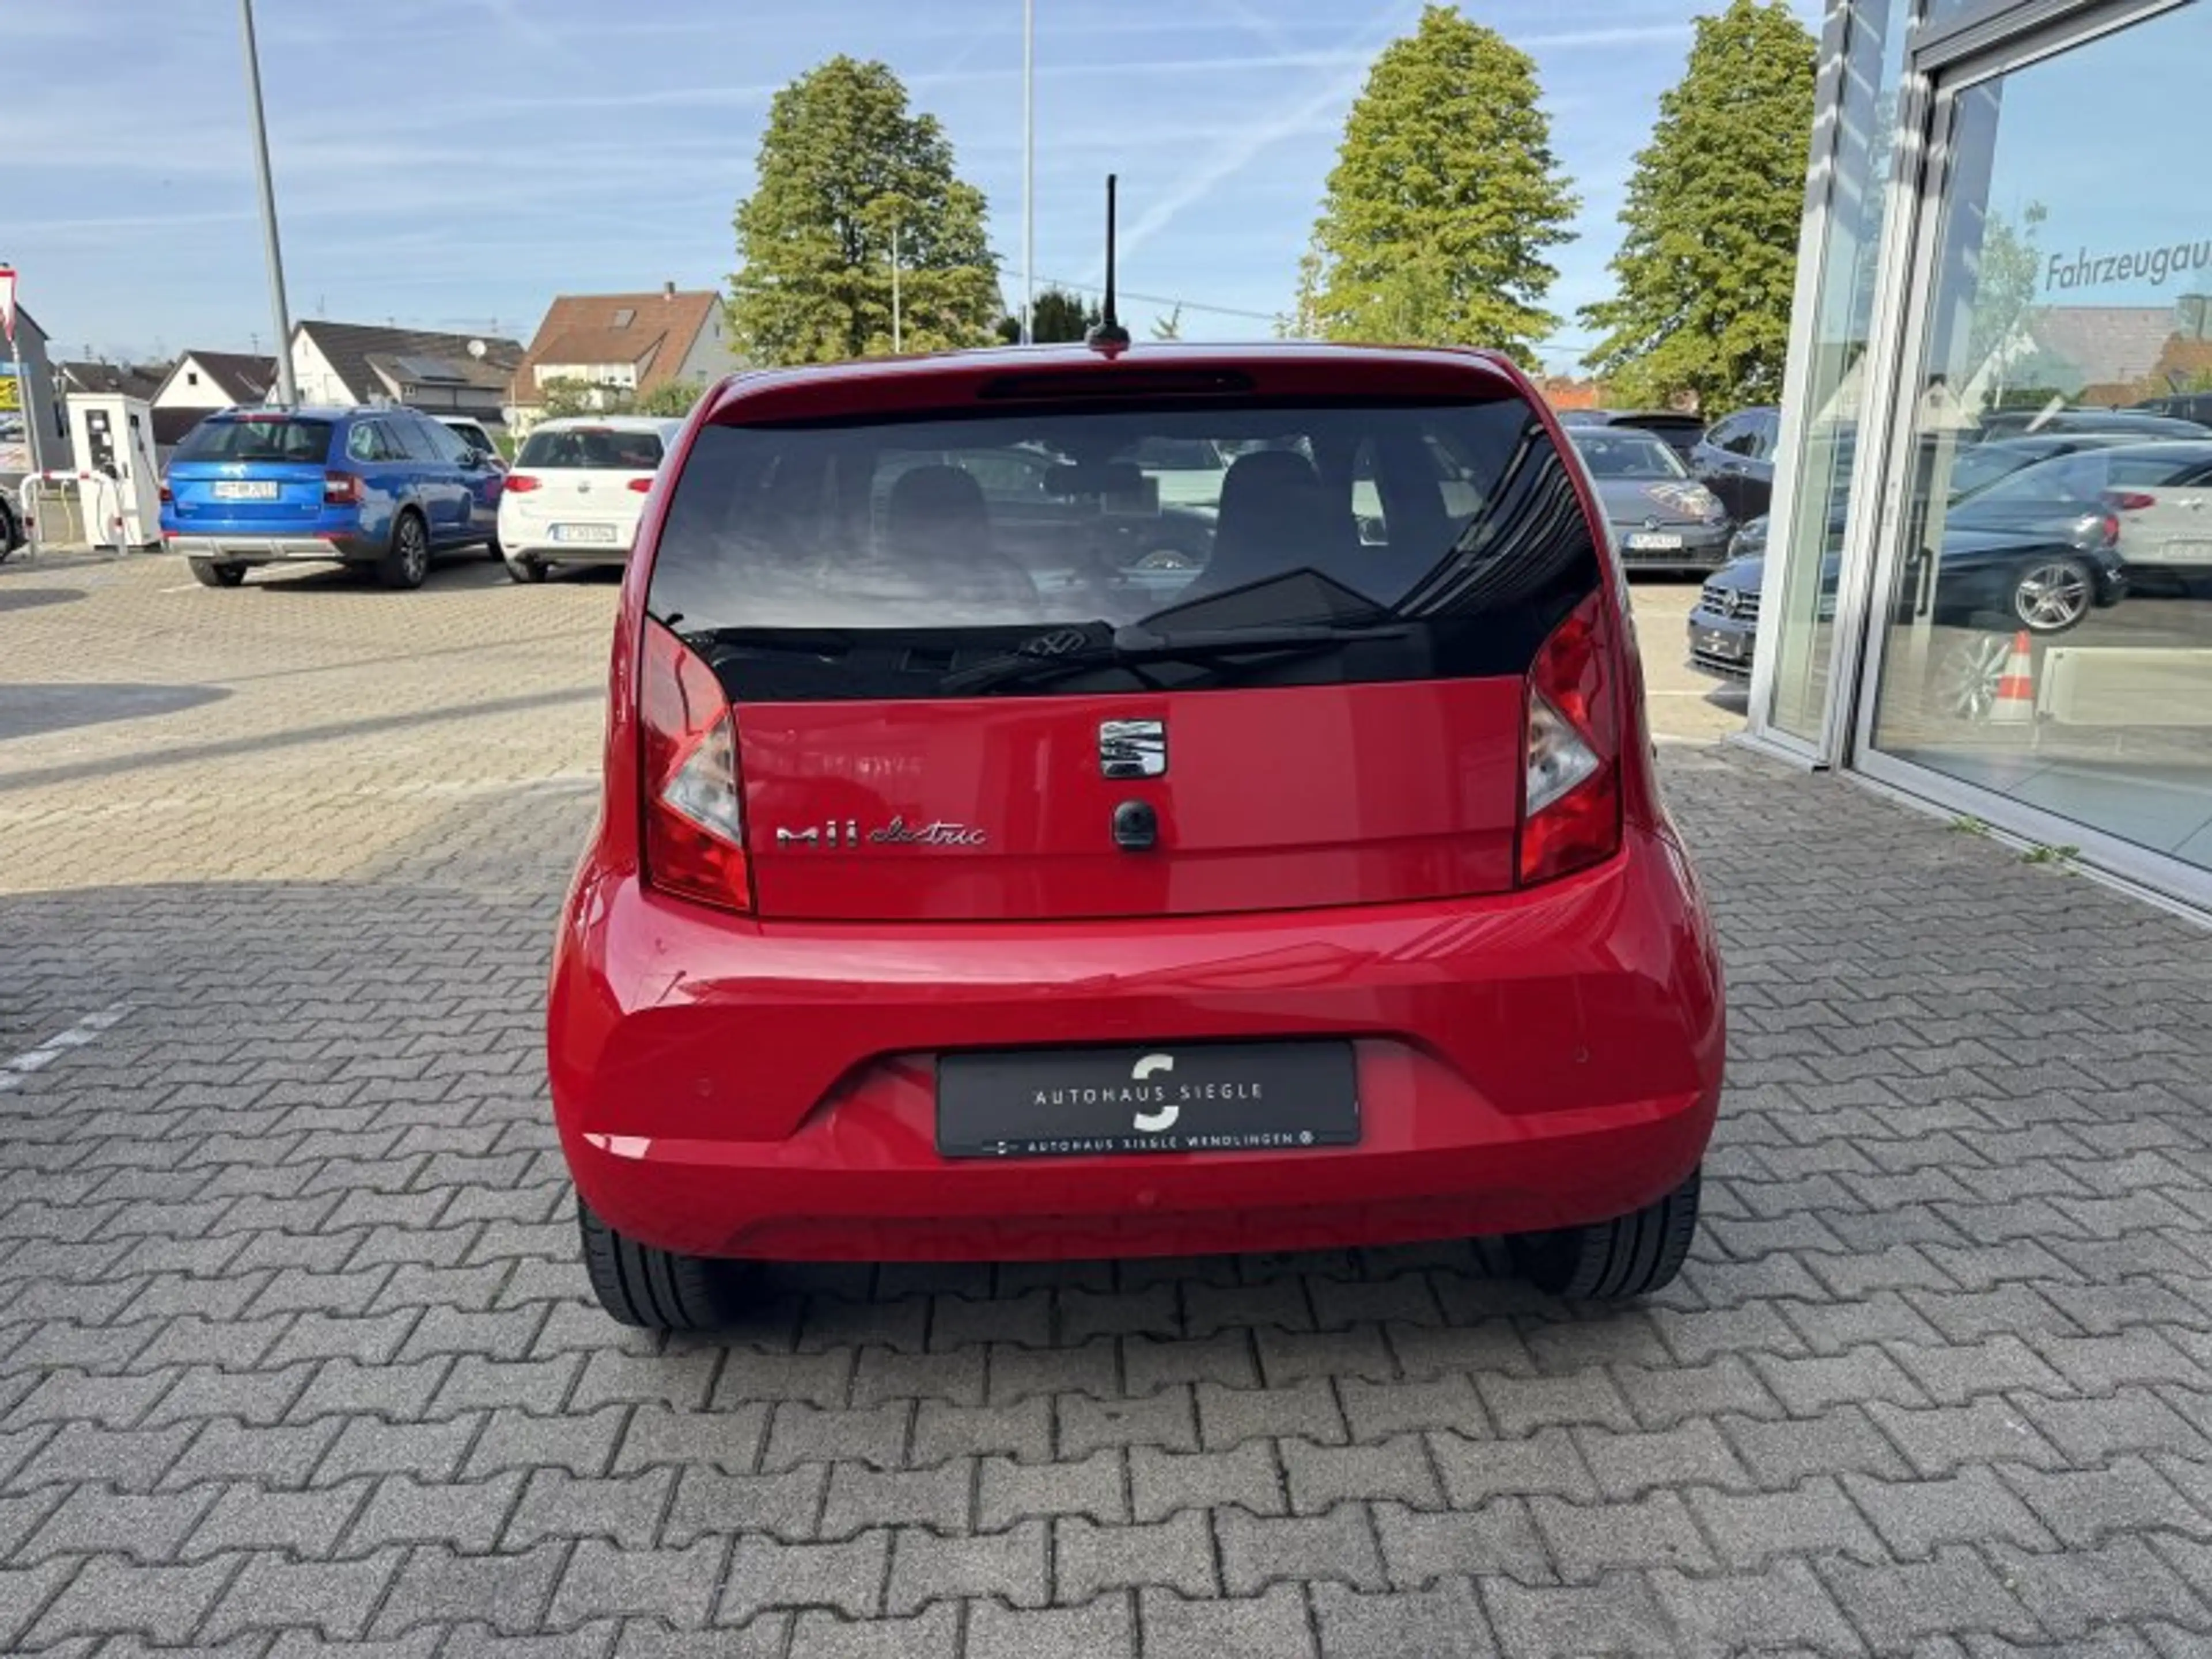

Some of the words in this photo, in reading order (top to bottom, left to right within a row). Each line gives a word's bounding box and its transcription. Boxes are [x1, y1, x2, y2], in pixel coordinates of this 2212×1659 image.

[2046, 240, 2212, 291] Fahrzeugau
[777, 820, 857, 847] Mii
[867, 816, 985, 846] electric
[1035, 1086, 1164, 1105] AUTOHAUS
[1179, 1084, 1262, 1100] SIEGLE
[1028, 1139, 1113, 1152] AUTOHAUS
[1186, 1132, 1293, 1147] WENDLINGEN
